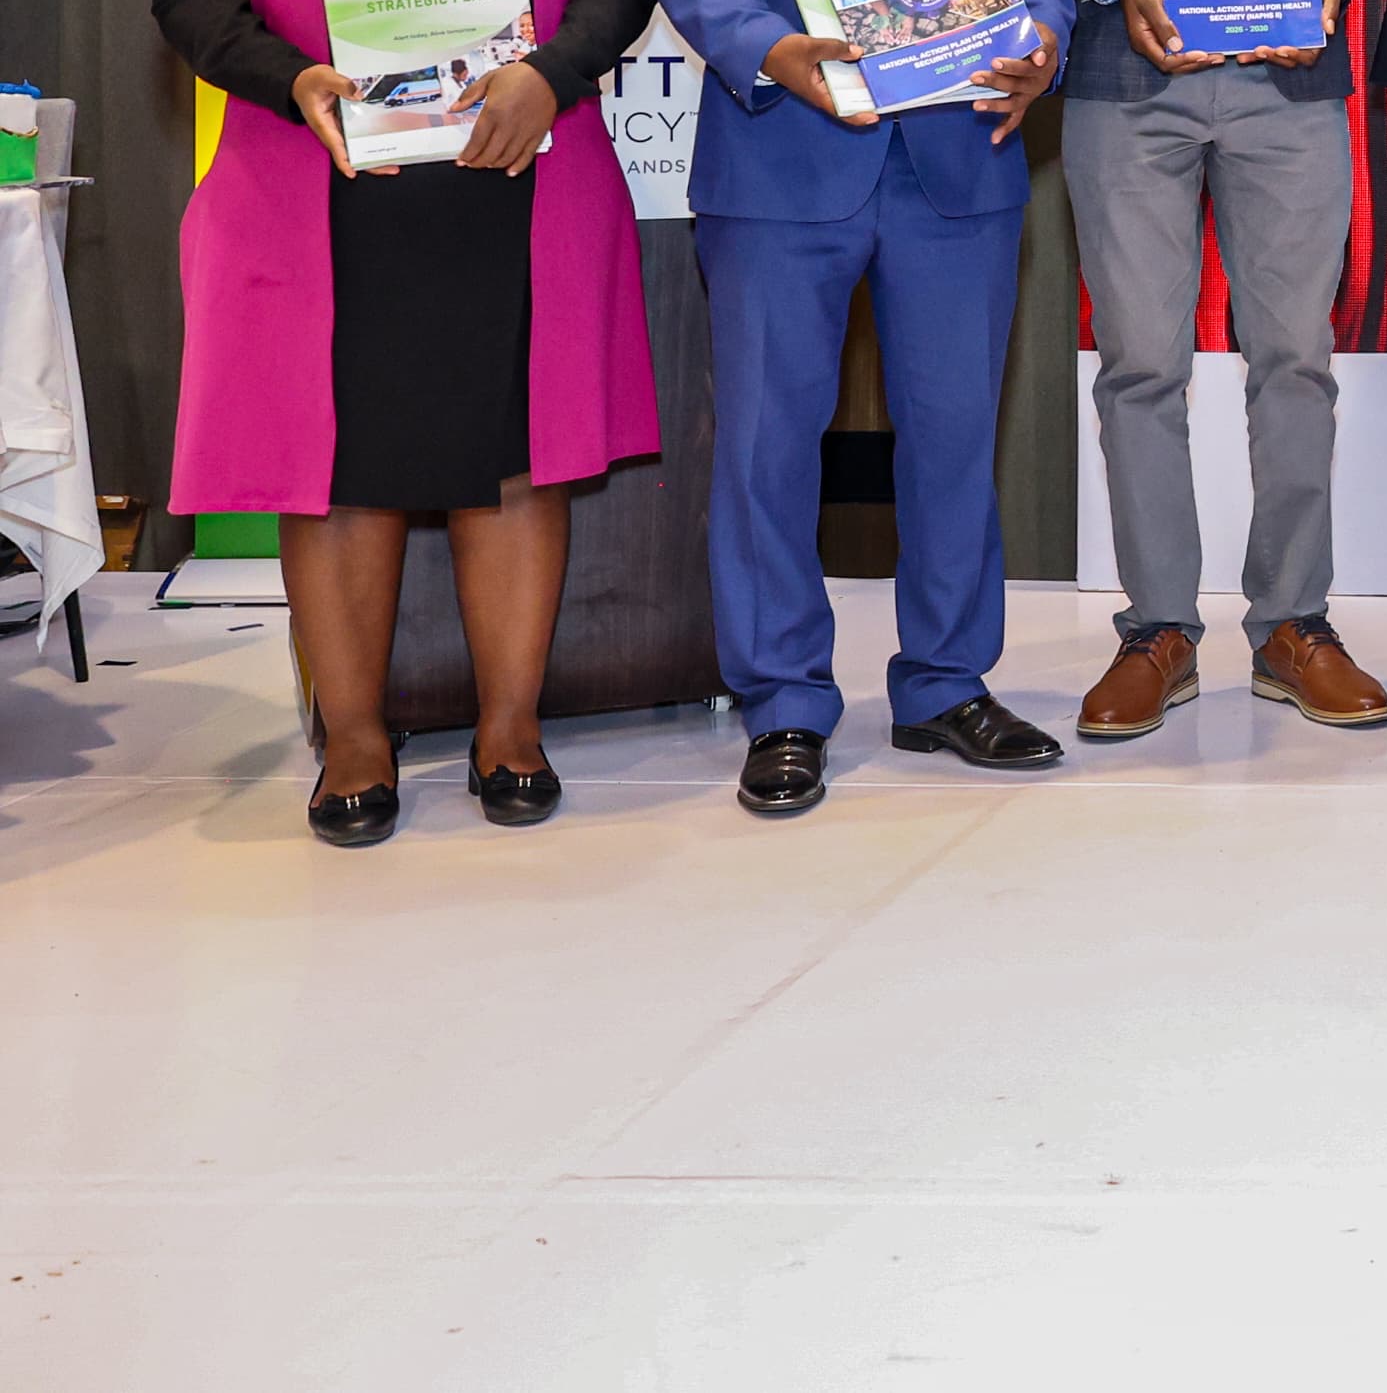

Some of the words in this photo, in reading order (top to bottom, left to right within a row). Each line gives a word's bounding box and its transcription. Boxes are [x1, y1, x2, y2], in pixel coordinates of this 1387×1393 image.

[1179, 6, 1215, 14] NATIONAL
[1216, 5, 1244, 13] ACTION
[1245, 3, 1265, 12] PLAN
[1266, 2, 1281, 11] FOR
[1282, 1, 1312, 10] HEALTH
[1209, 13, 1245, 22] SECURITY
[627, 159, 686, 174] ANDS
